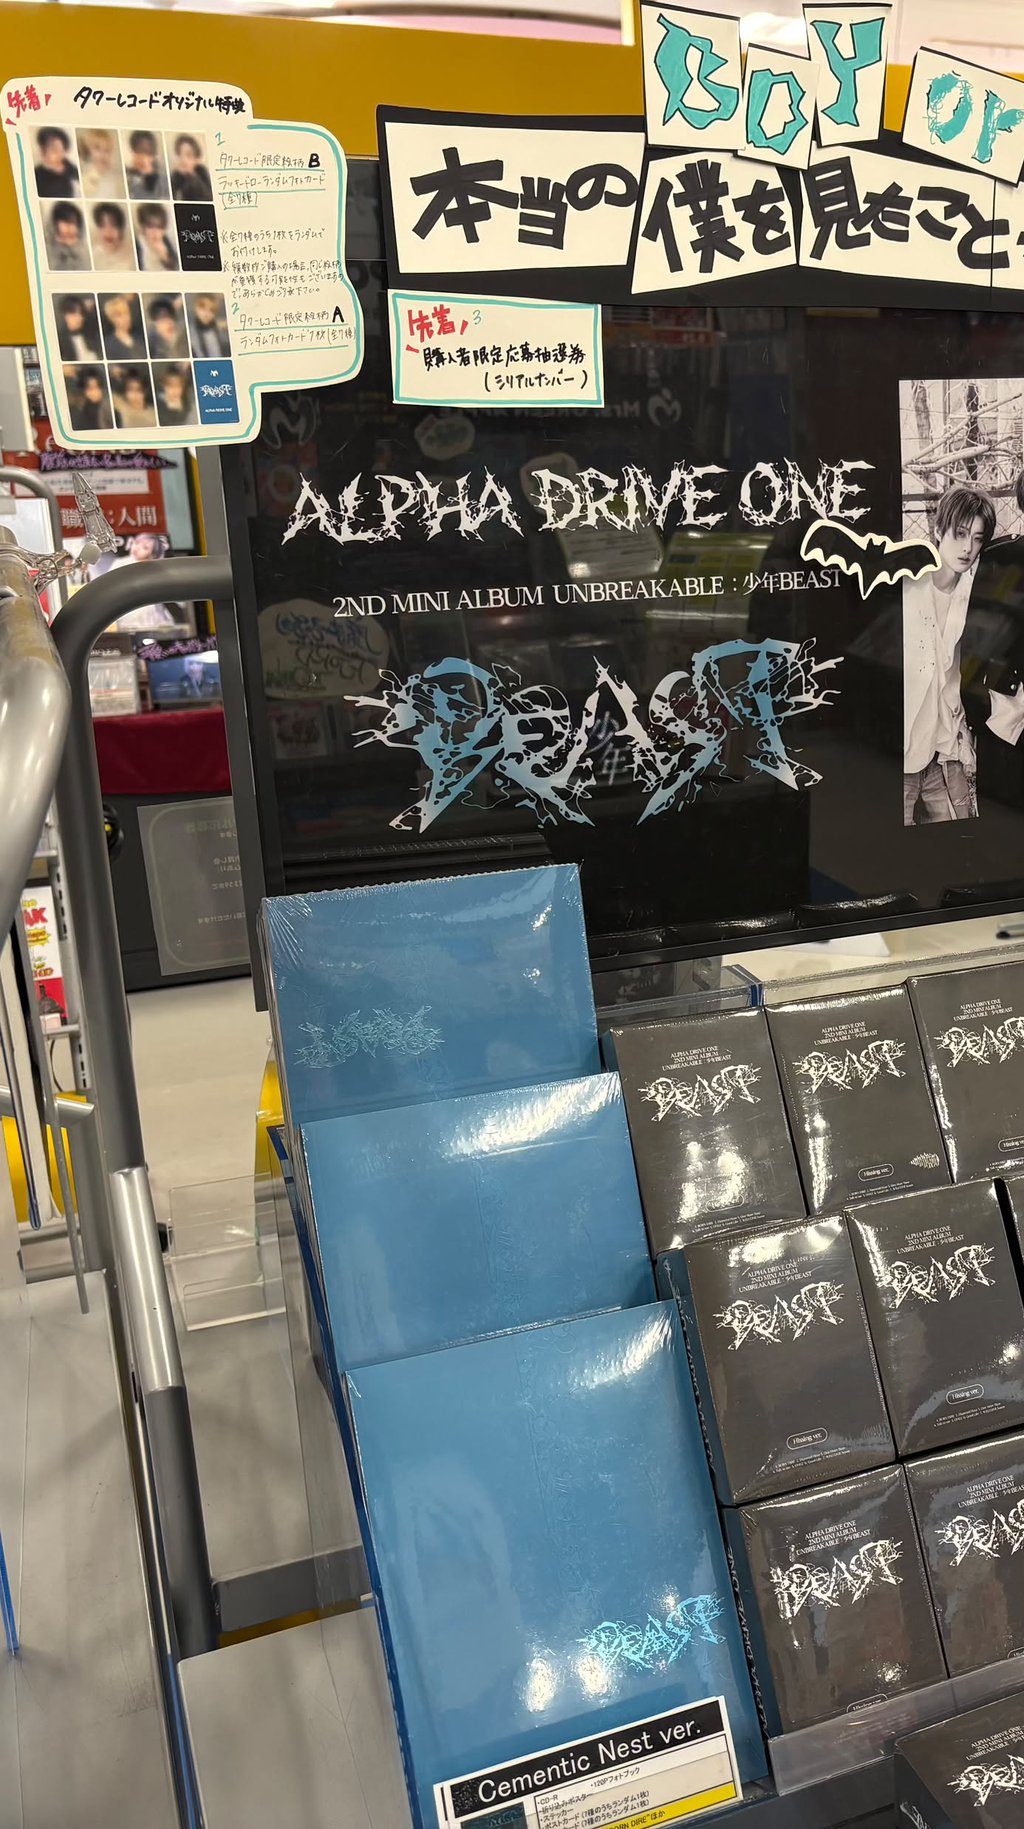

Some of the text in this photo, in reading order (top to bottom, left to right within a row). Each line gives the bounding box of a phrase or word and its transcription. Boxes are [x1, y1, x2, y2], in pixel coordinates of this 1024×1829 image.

[653, 13, 885, 155] BOY
[423, 341, 587, 372] 購入者限定応募抽選券
[281, 456, 876, 547] ALPHA DRIVE ONE
[333, 594, 387, 618] 2ND
[391, 591, 451, 615] MINI
[455, 585, 544, 611] ALBUM
[552, 575, 725, 604] UNBREAKABLE
[343, 637, 845, 834] BEAST
[477, 1718, 701, 1802] Cementic Nest ver.
